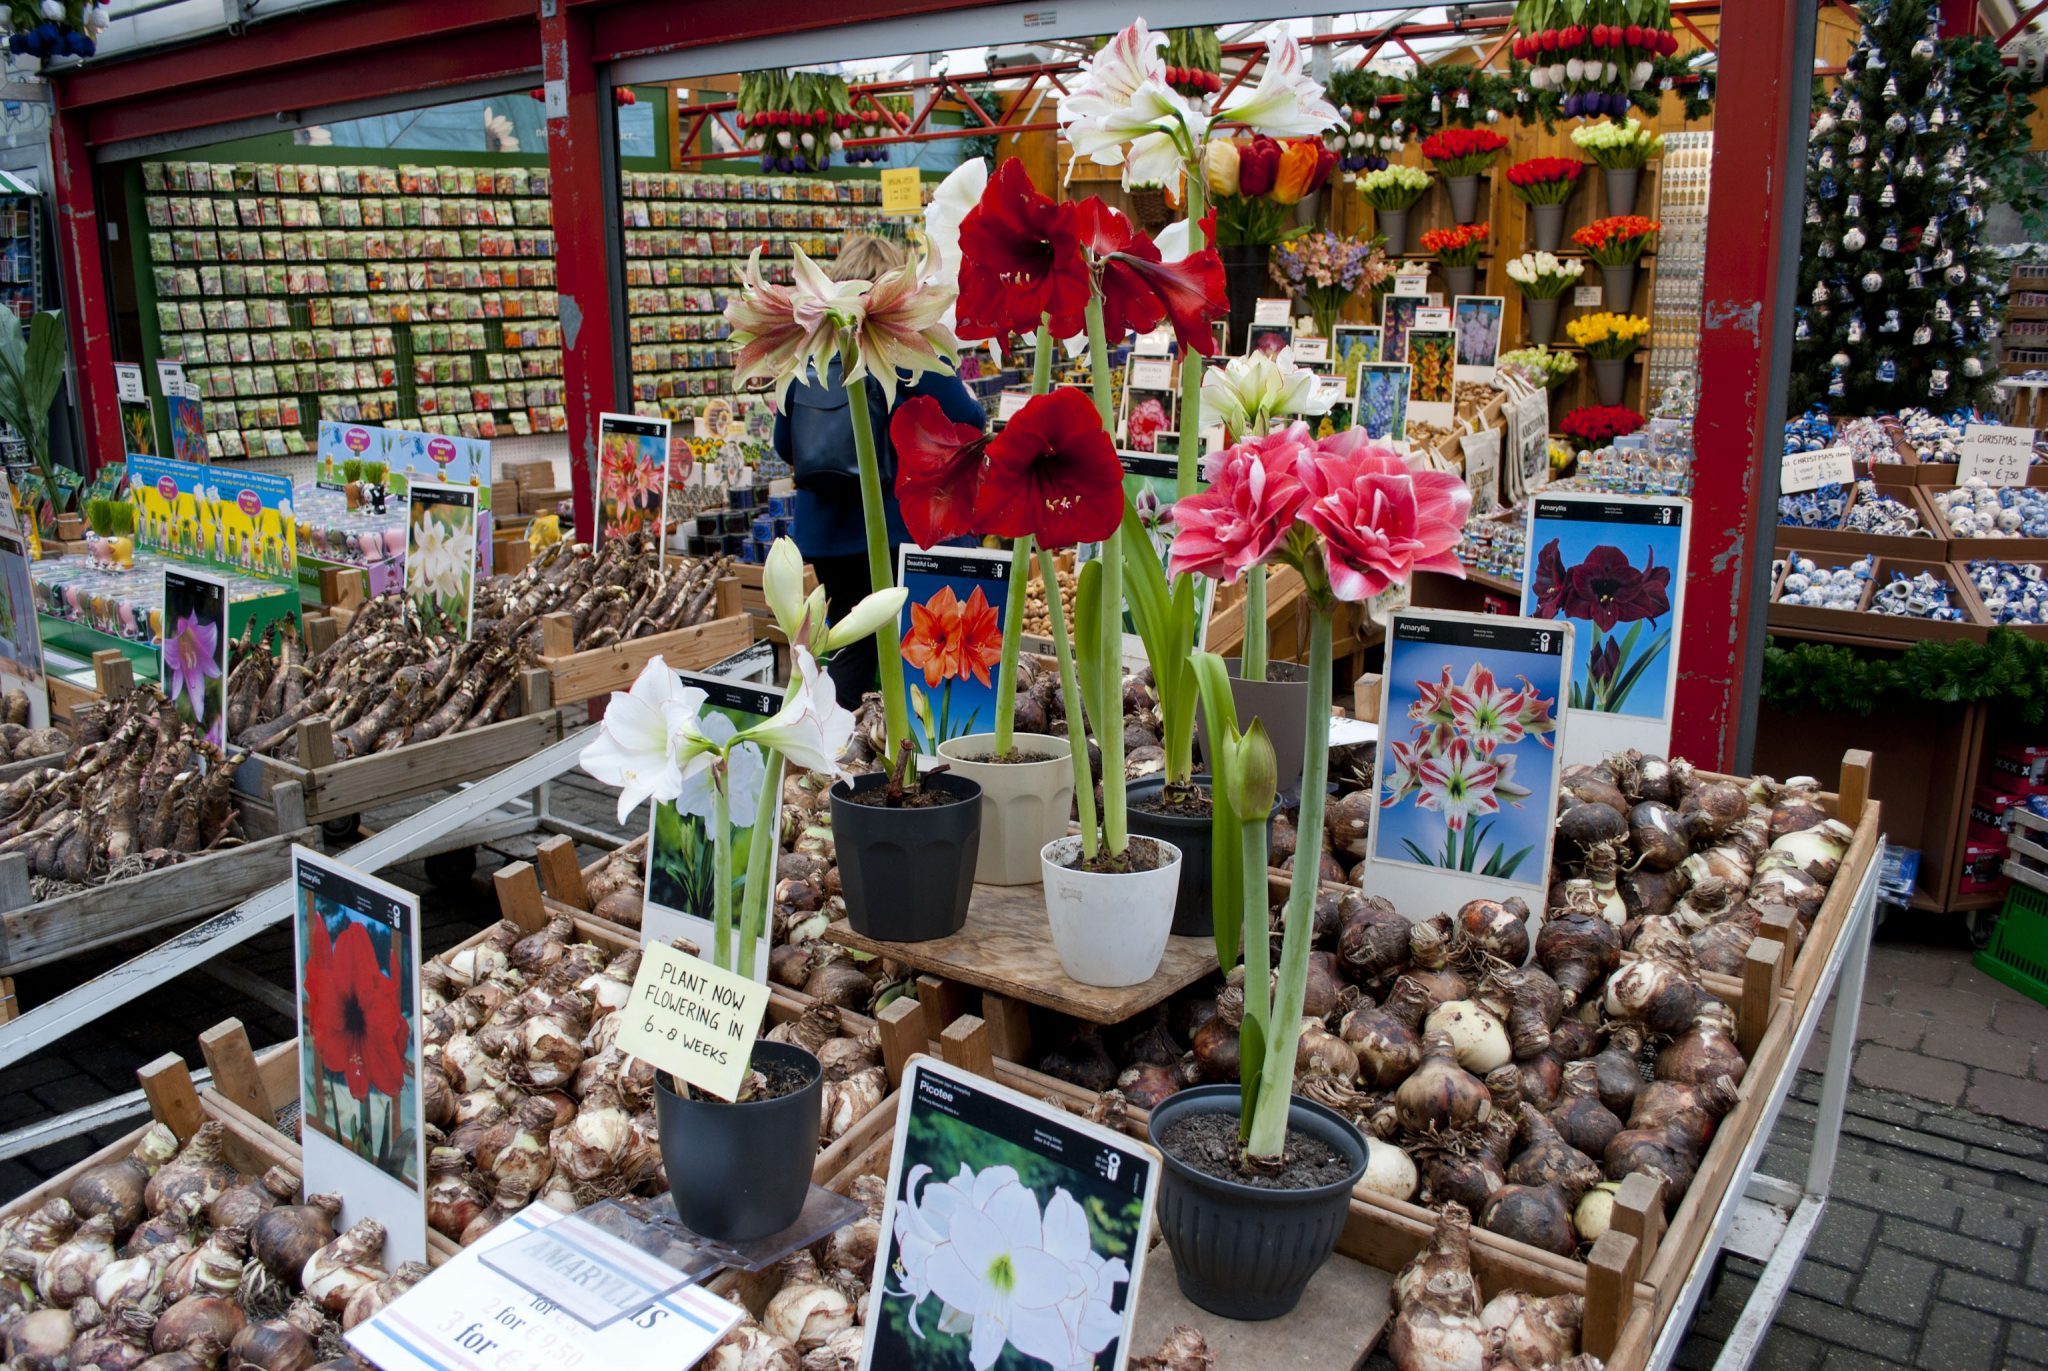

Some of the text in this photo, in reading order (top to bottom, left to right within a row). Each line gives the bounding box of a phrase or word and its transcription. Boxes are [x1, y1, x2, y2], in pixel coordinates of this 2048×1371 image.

[1977, 433, 2017, 446] CHRISTMAS
[1793, 452, 1834, 466] CHRISTMAS
[1540, 504, 1567, 513] Amaryllis
[907, 559, 939, 569] Beautiful Lady
[1400, 623, 1430, 633] Amaryllis
[300, 869, 321, 885] Amaryllis
[660, 961, 746, 1012] PLANT NOW
[644, 983, 745, 1041] FLOWERING IN
[683, 1033, 728, 1066] WEEKS
[919, 1079, 954, 1103] Picotee
[521, 1240, 671, 1330] AMARYLLIS
[529, 1293, 558, 1316] for
[494, 1306, 528, 1331] for
[453, 1322, 500, 1355] for
